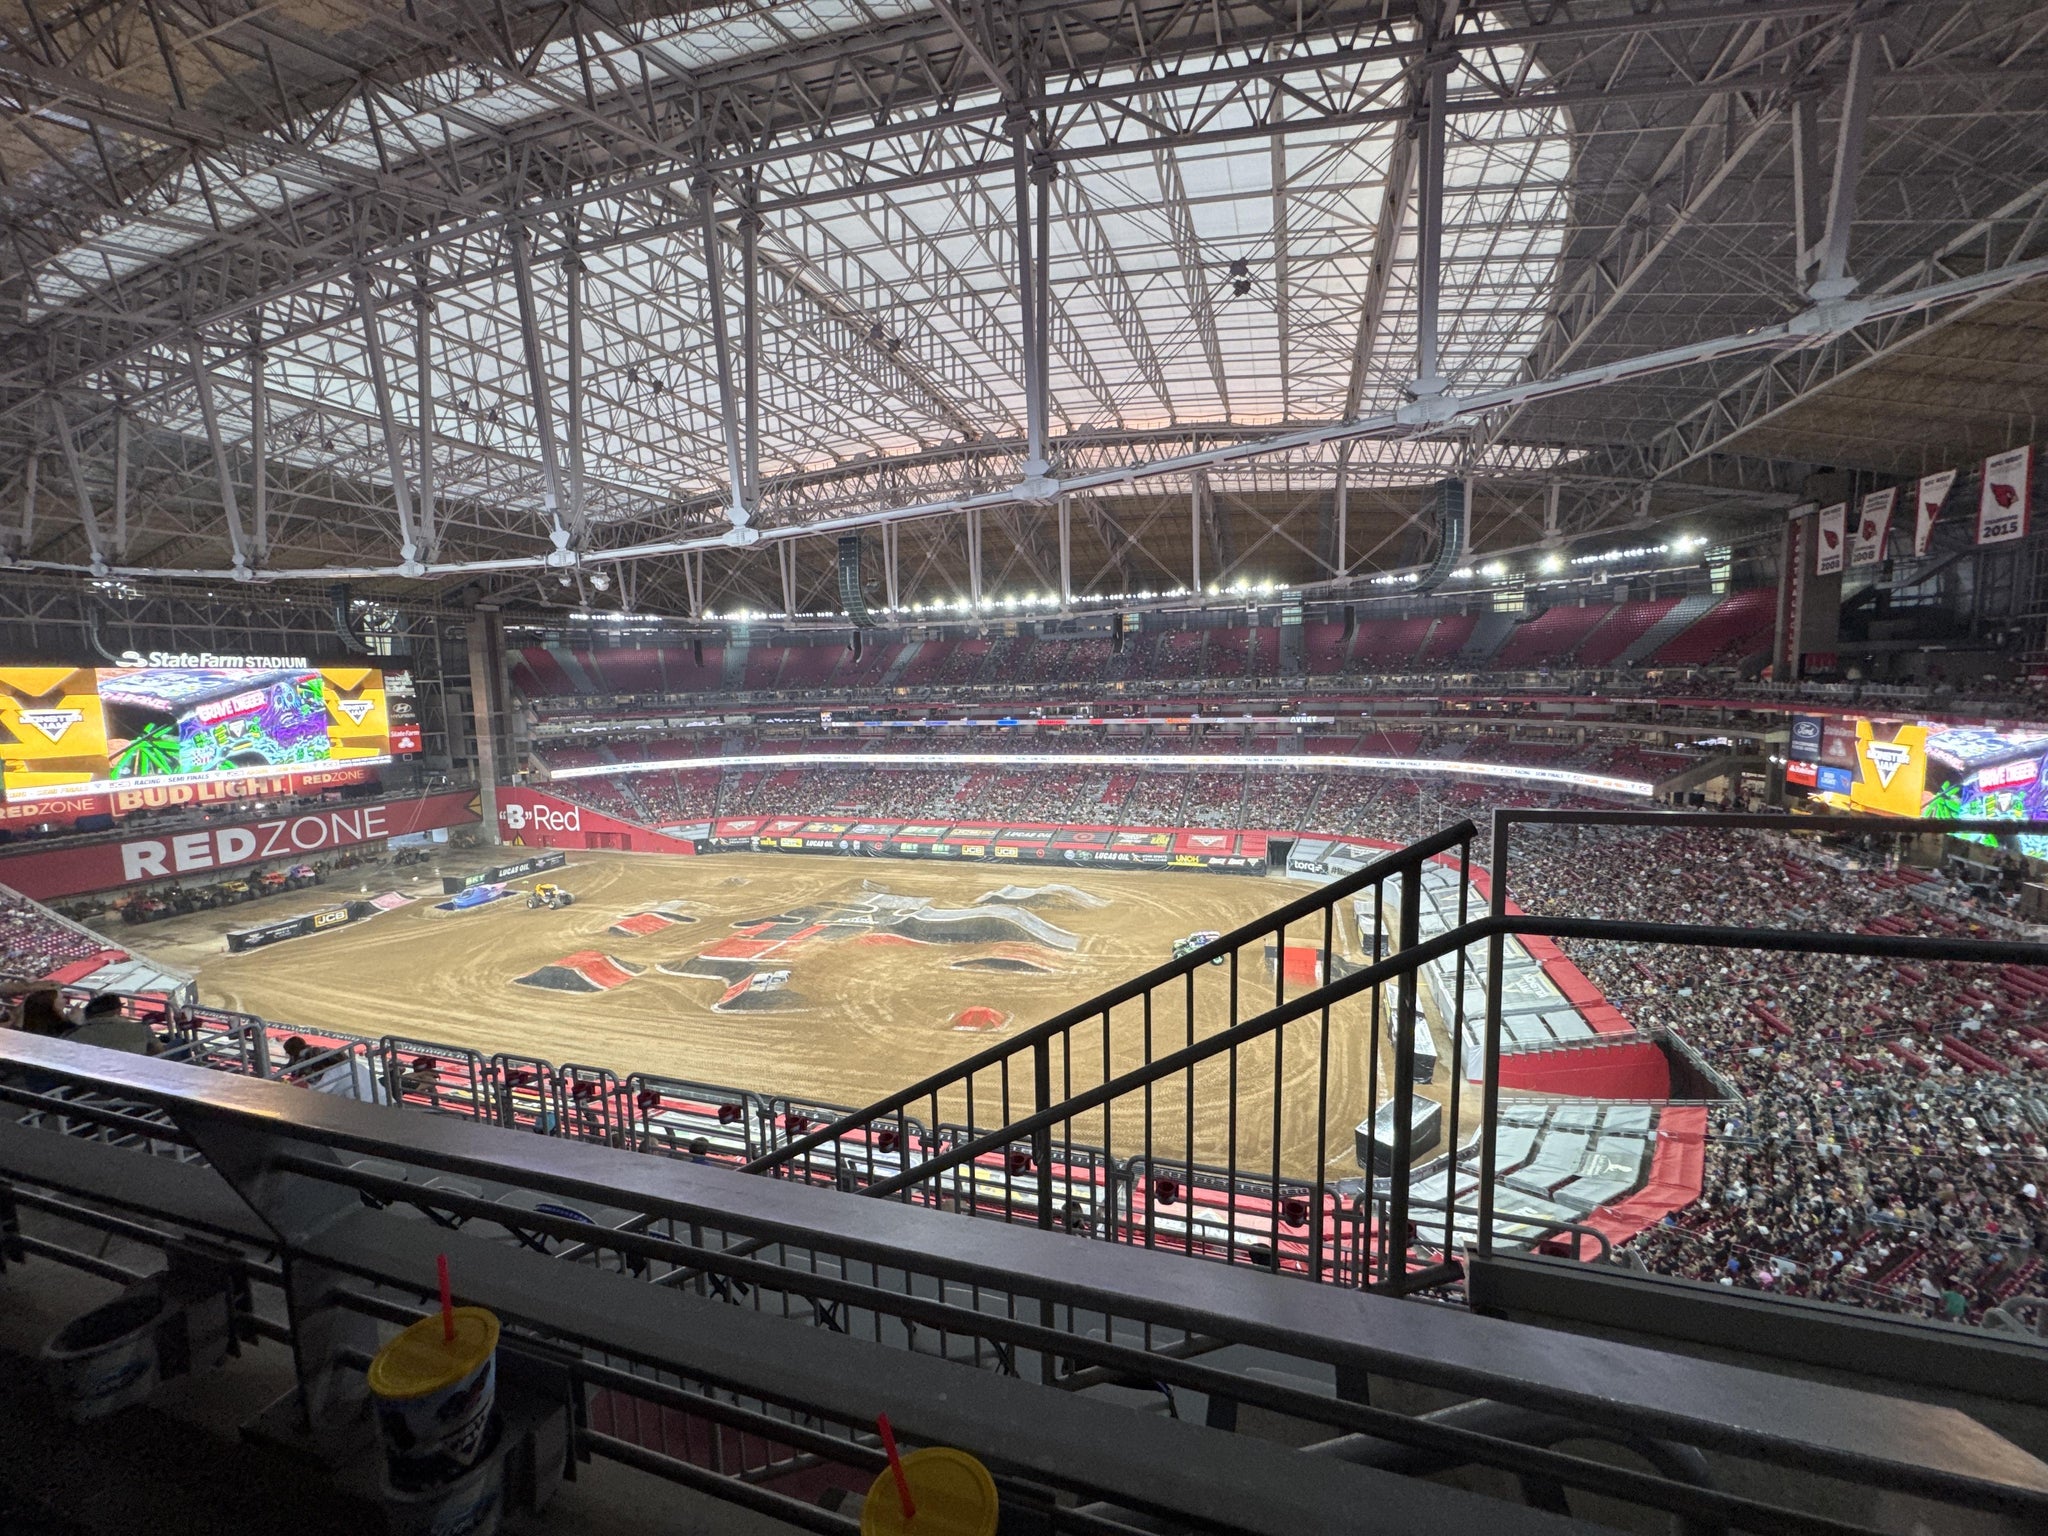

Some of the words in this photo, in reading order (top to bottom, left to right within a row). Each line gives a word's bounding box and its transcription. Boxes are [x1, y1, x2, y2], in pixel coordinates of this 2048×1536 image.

[1982, 521, 2018, 538] 2015
[1821, 560, 1840, 571] 2008
[246, 656, 307, 668] STADIUM
[198, 700, 233, 721] GRAVE
[235, 691, 266, 715] DIGGER
[1797, 723, 1815, 736] Ford
[134, 778, 161, 786] RACING
[168, 775, 185, 783] SEMI
[186, 773, 210, 781] FINALS
[303, 769, 365, 786] REDZONE
[118, 782, 193, 810] BUD
[199, 775, 286, 801] LIGHT
[121, 806, 388, 881] REDZONE
[1095, 852, 1117, 860] LUCAS
[1118, 853, 1129, 861] OIL
[498, 865, 519, 877] LUCAS
[519, 863, 530, 871] OIL
[318, 911, 345, 924] JCB
